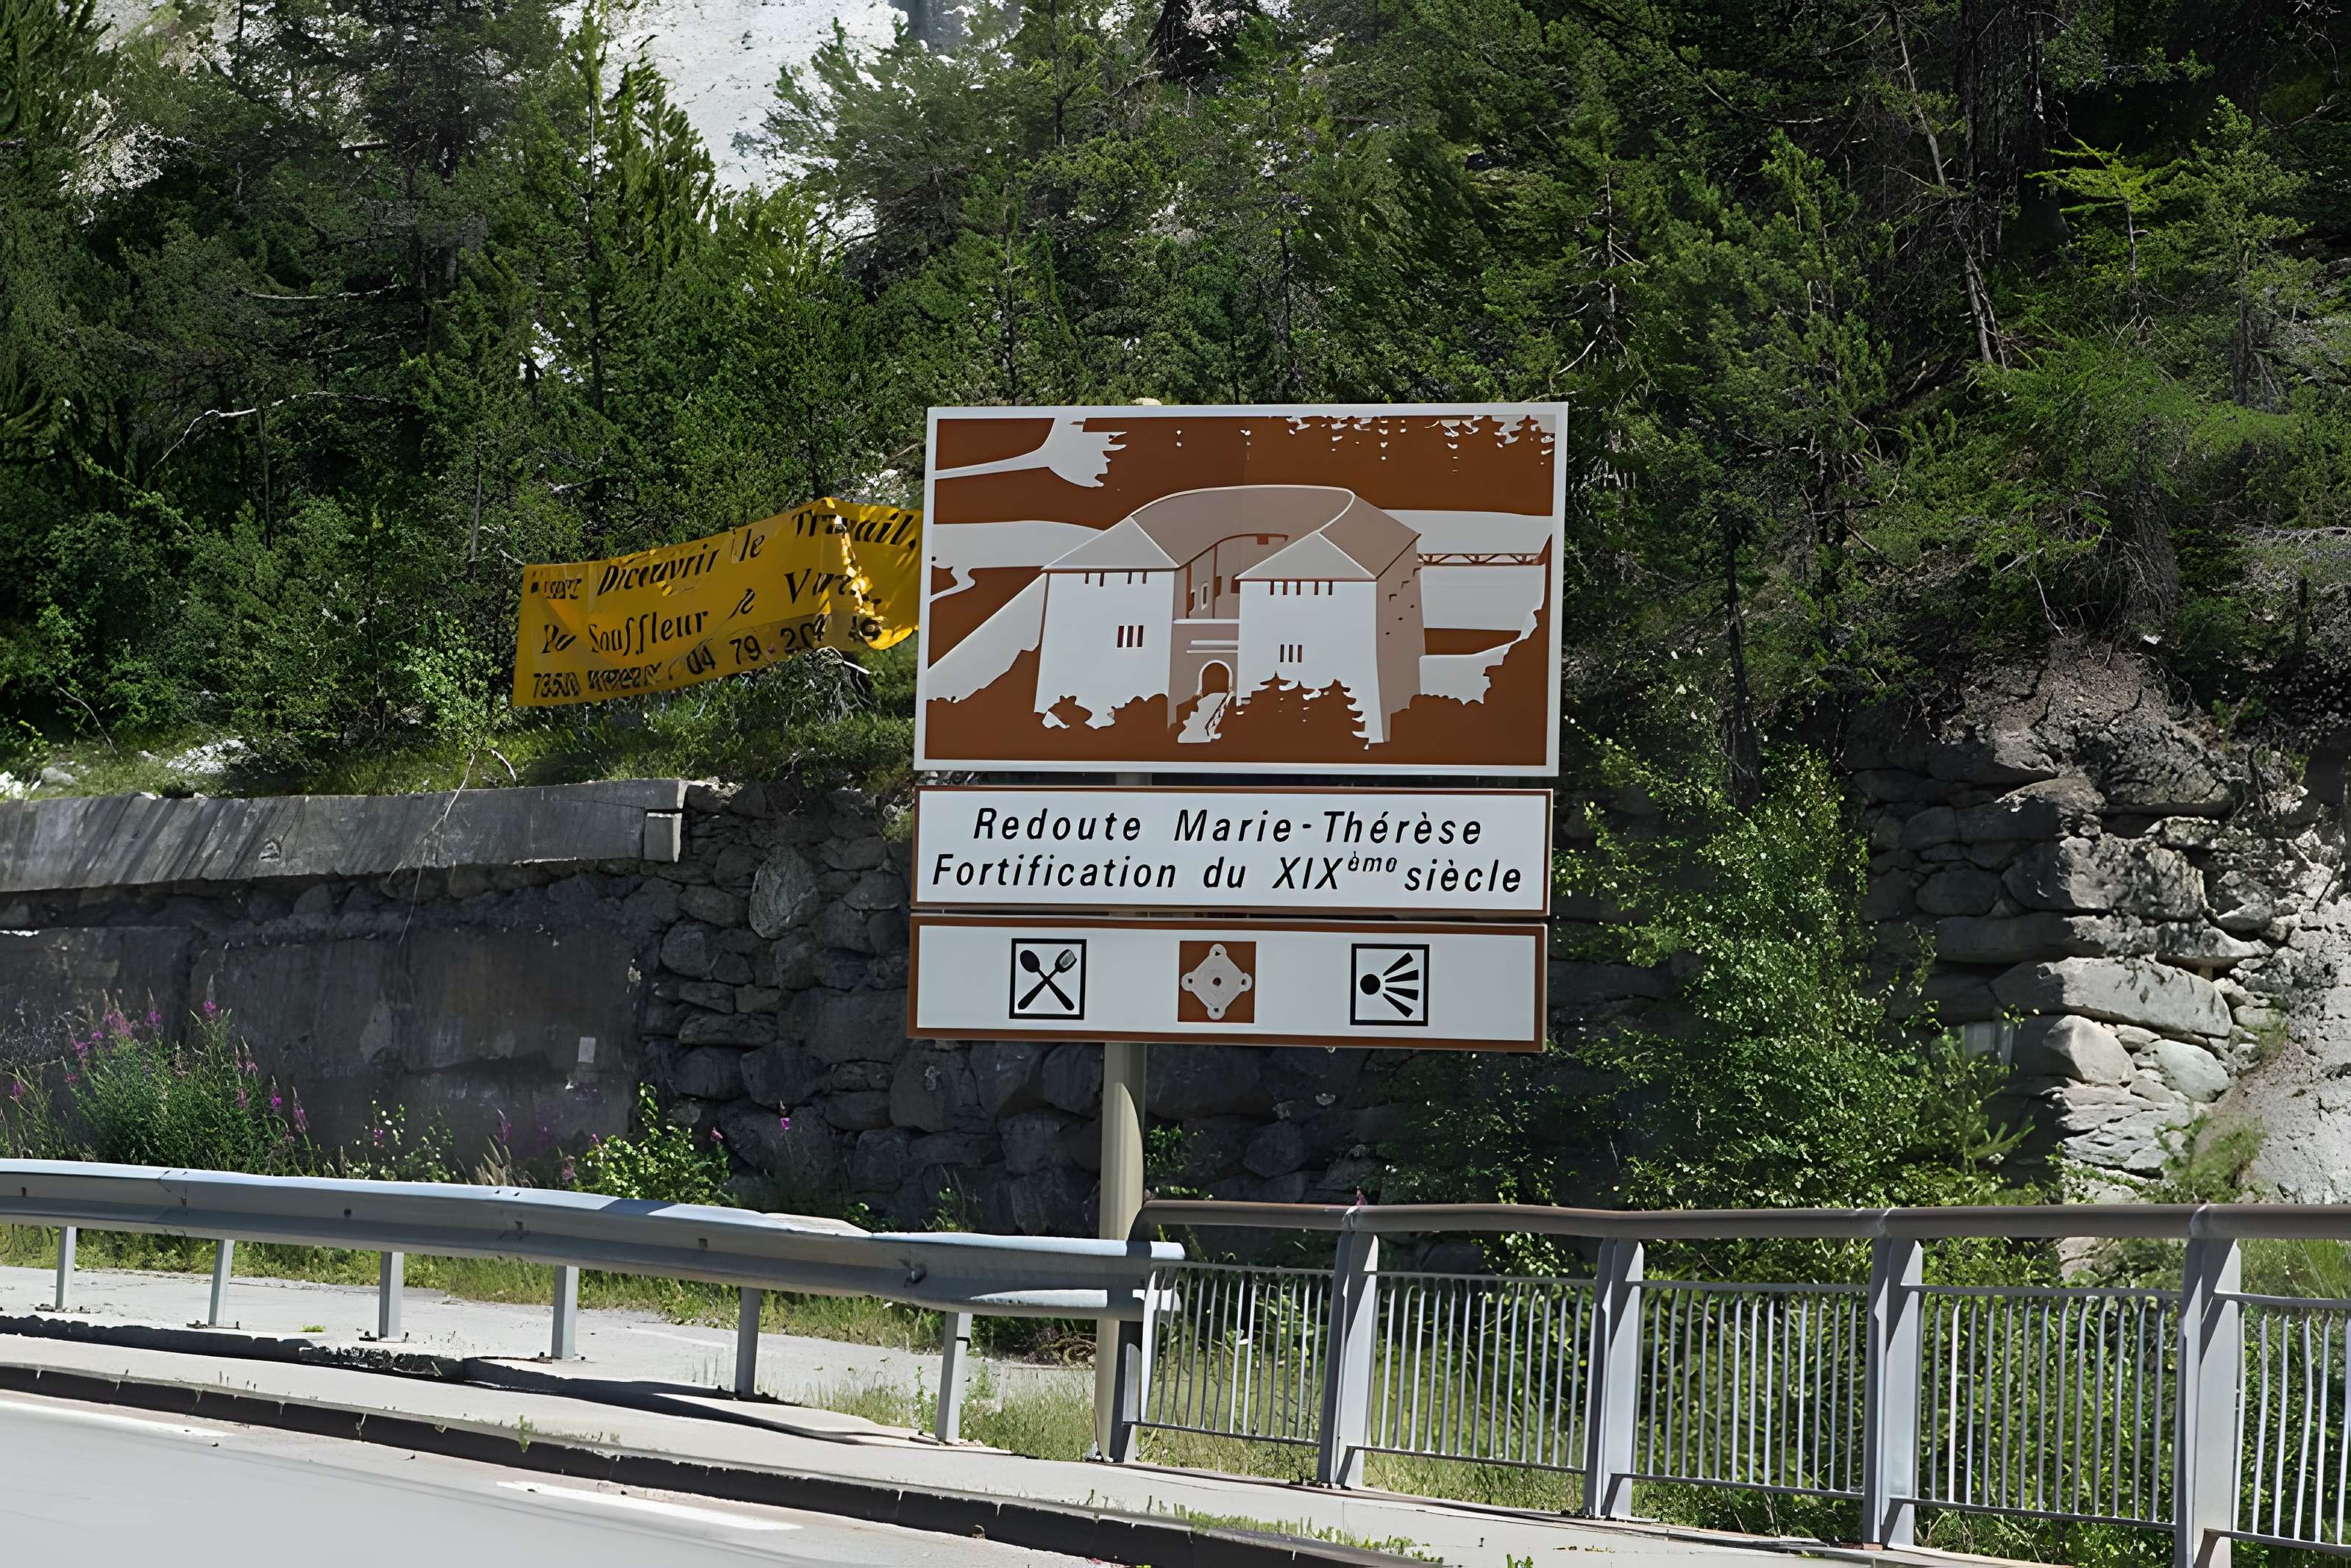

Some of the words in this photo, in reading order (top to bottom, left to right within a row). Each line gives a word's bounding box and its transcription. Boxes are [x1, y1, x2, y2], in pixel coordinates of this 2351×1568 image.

[973, 808, 1142, 842] Redoute
[1173, 809, 1481, 846] Marie-Thérèse
[932, 853, 1176, 888] Fortification
[1203, 856, 1246, 889] du
[1404, 858, 1521, 893] siècle
